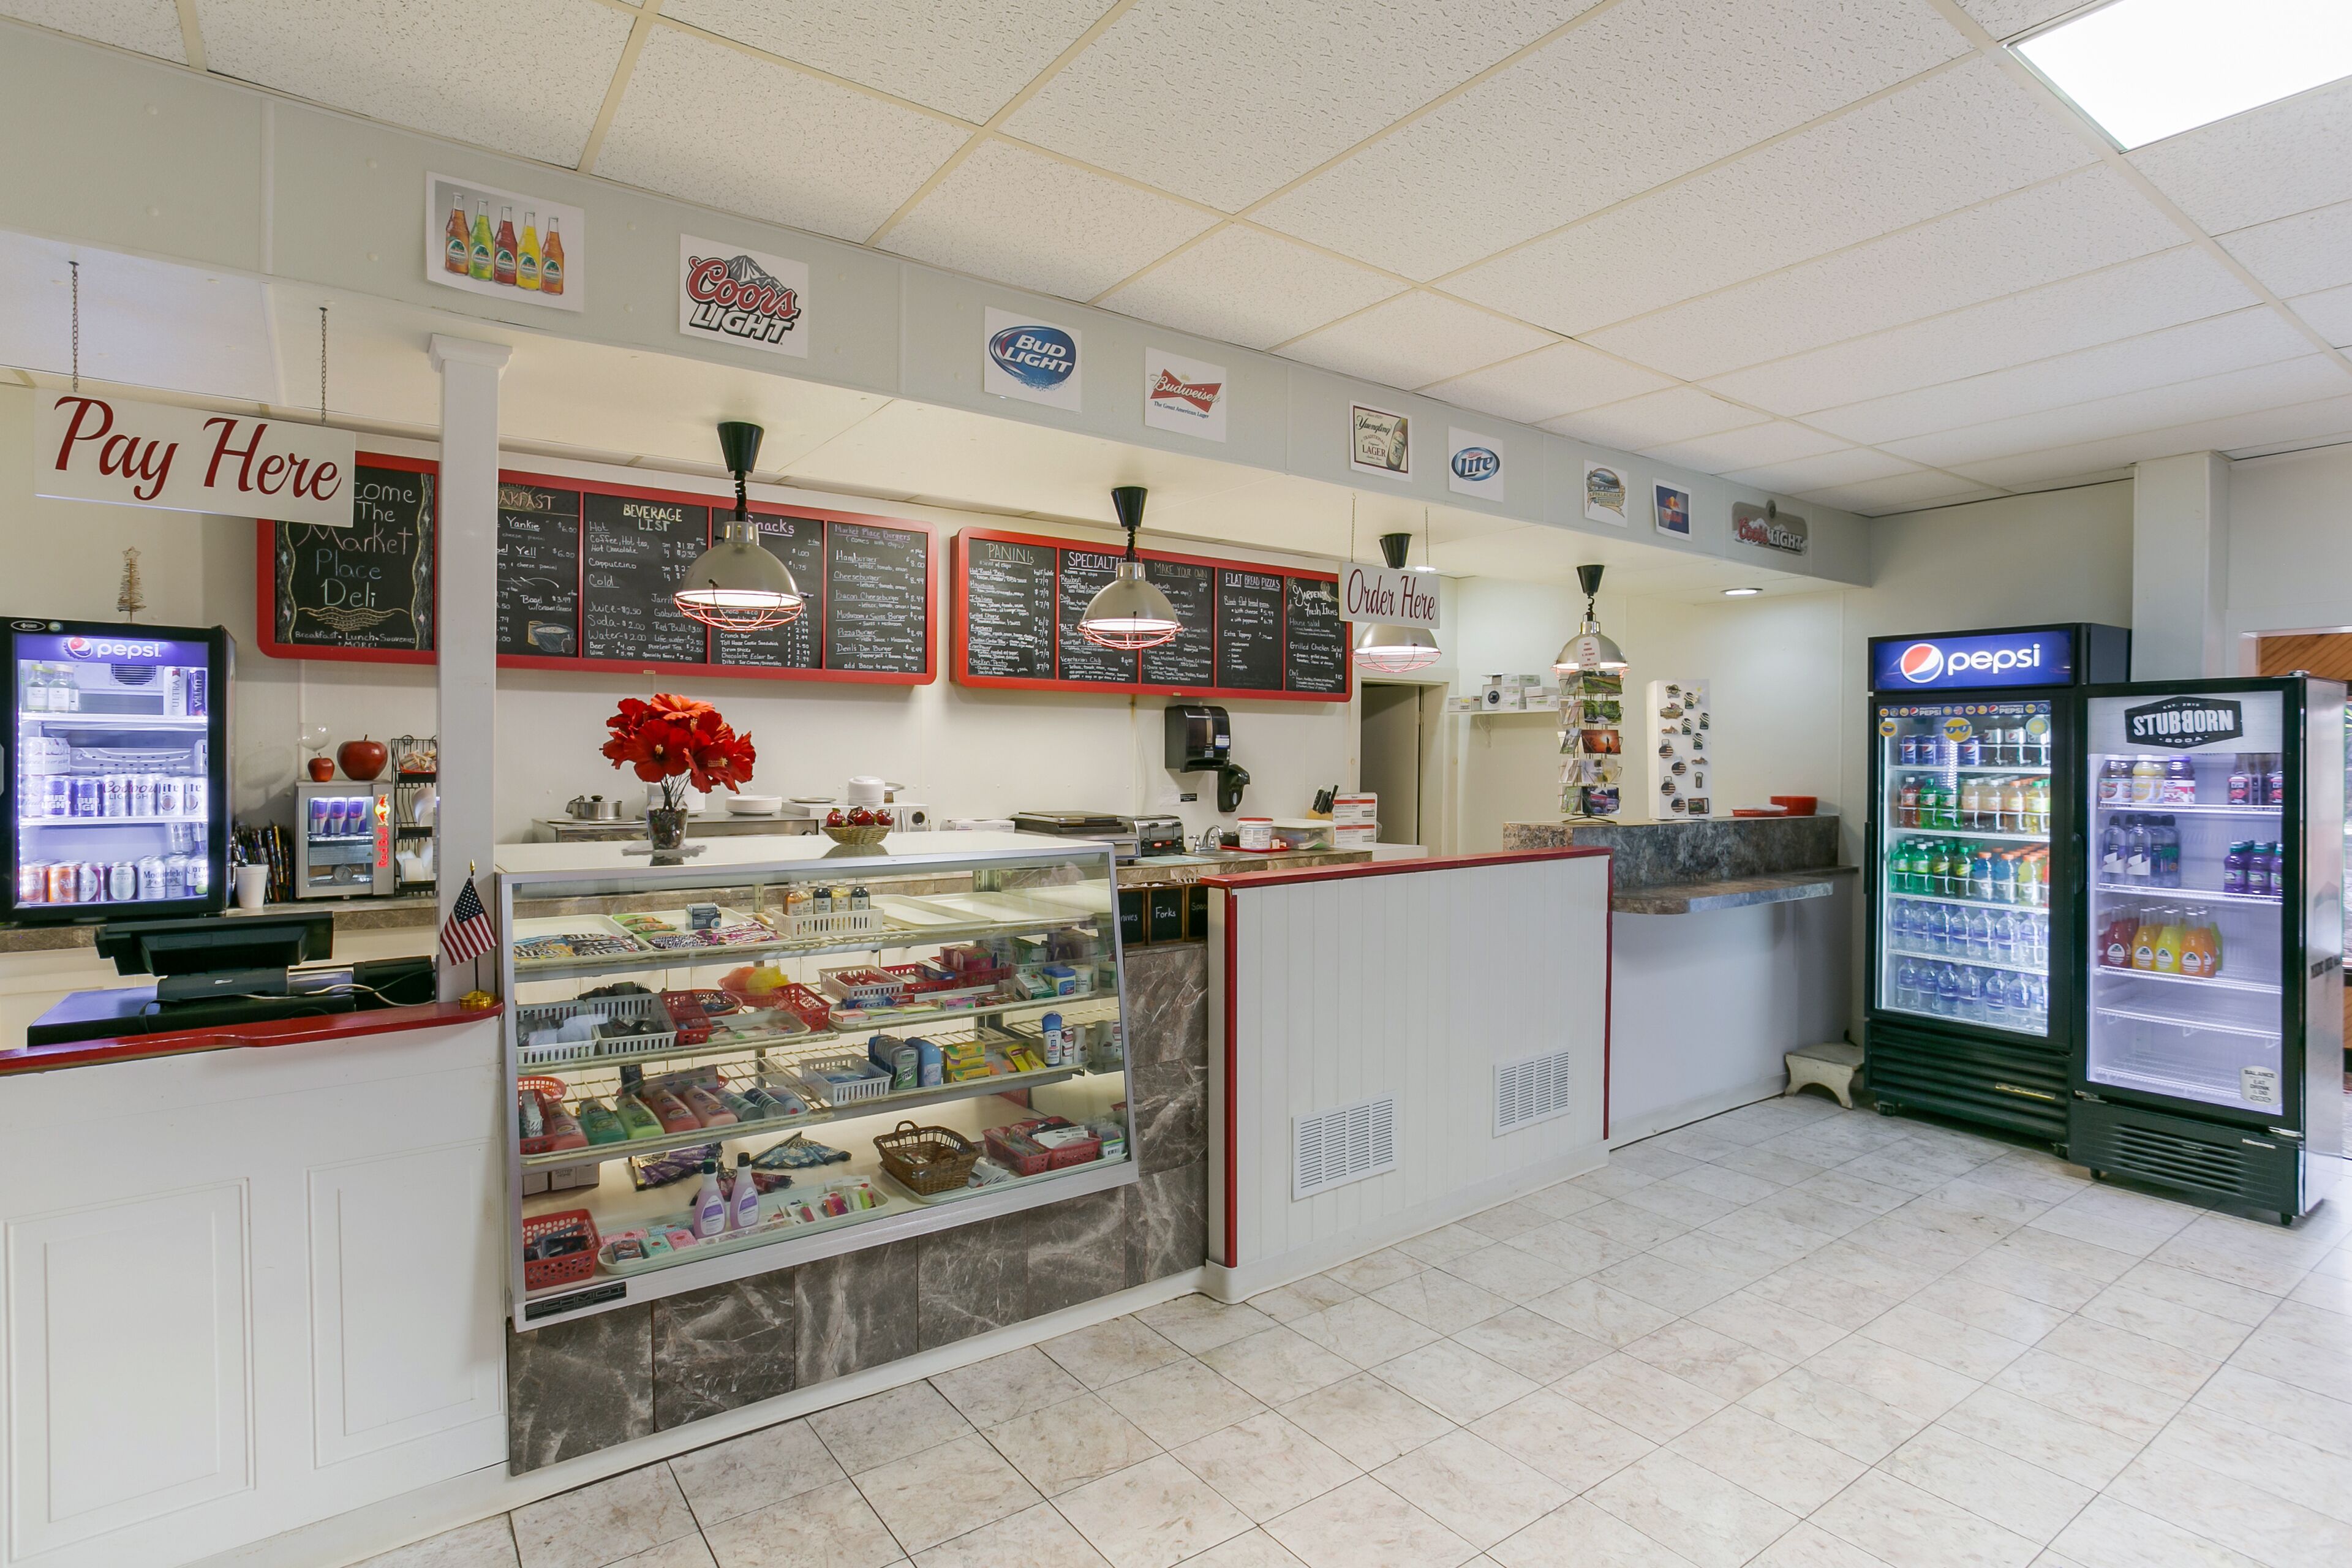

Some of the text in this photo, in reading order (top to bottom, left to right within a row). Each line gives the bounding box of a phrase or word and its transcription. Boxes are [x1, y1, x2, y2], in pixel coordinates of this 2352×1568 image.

[687, 256, 801, 319] Coors
[689, 303, 794, 344] LIGHT
[1015, 334, 1066, 358] BUD
[1003, 346, 1072, 373] LIGHT
[1152, 374, 1220, 403] Budweiser
[1176, 406, 1196, 416] American
[1355, 415, 1392, 436] Yuengling
[55, 396, 342, 501] Pay Here
[1362, 444, 1386, 458] LAGER
[1459, 456, 1493, 478] Lite
[356, 501, 395, 522] The
[623, 503, 682, 522] BEVERAGE
[589, 521, 609, 532] Hot
[638, 518, 670, 532] LIST
[834, 524, 911, 541] Market Place Burgers
[296, 522, 413, 555] Market
[1769, 529, 1803, 551] LIGHT
[516, 545, 536, 557] Yell
[836, 549, 880, 562] Hamburger
[315, 548, 382, 579] Place
[588, 558, 637, 570] Cappuccino
[1154, 562, 1208, 578] MAKE YOUR OWN
[589, 574, 614, 587] Cold
[834, 571, 881, 581] Cheeseburger
[1060, 575, 1082, 583] Reuben
[1225, 572, 1280, 589] FLAT BREAD PIZZAS
[320, 578, 376, 608] Deli
[835, 589, 858, 600] Bacon
[860, 591, 900, 602] Cheeseburger
[1348, 568, 1436, 620] Order Here
[345, 632, 375, 641] Lunch
[837, 627, 855, 636] Pizza
[97, 643, 160, 660] pepsi
[836, 643, 857, 652] Devil's
[873, 645, 893, 654] Burger
[1290, 641, 1309, 650] Grilled
[1311, 643, 1330, 652] Chicken
[1948, 643, 2040, 676] pepsi
[194, 679, 202, 708] ULTRA
[2133, 709, 2234, 736] STUBBORN
[377, 827, 389, 868] Red Bull
[1155, 906, 1176, 918] Forks
[1191, 902, 1207, 912] Spoo
[1120, 913, 1137, 922] nives
[2244, 1069, 2275, 1078] BALANCE
